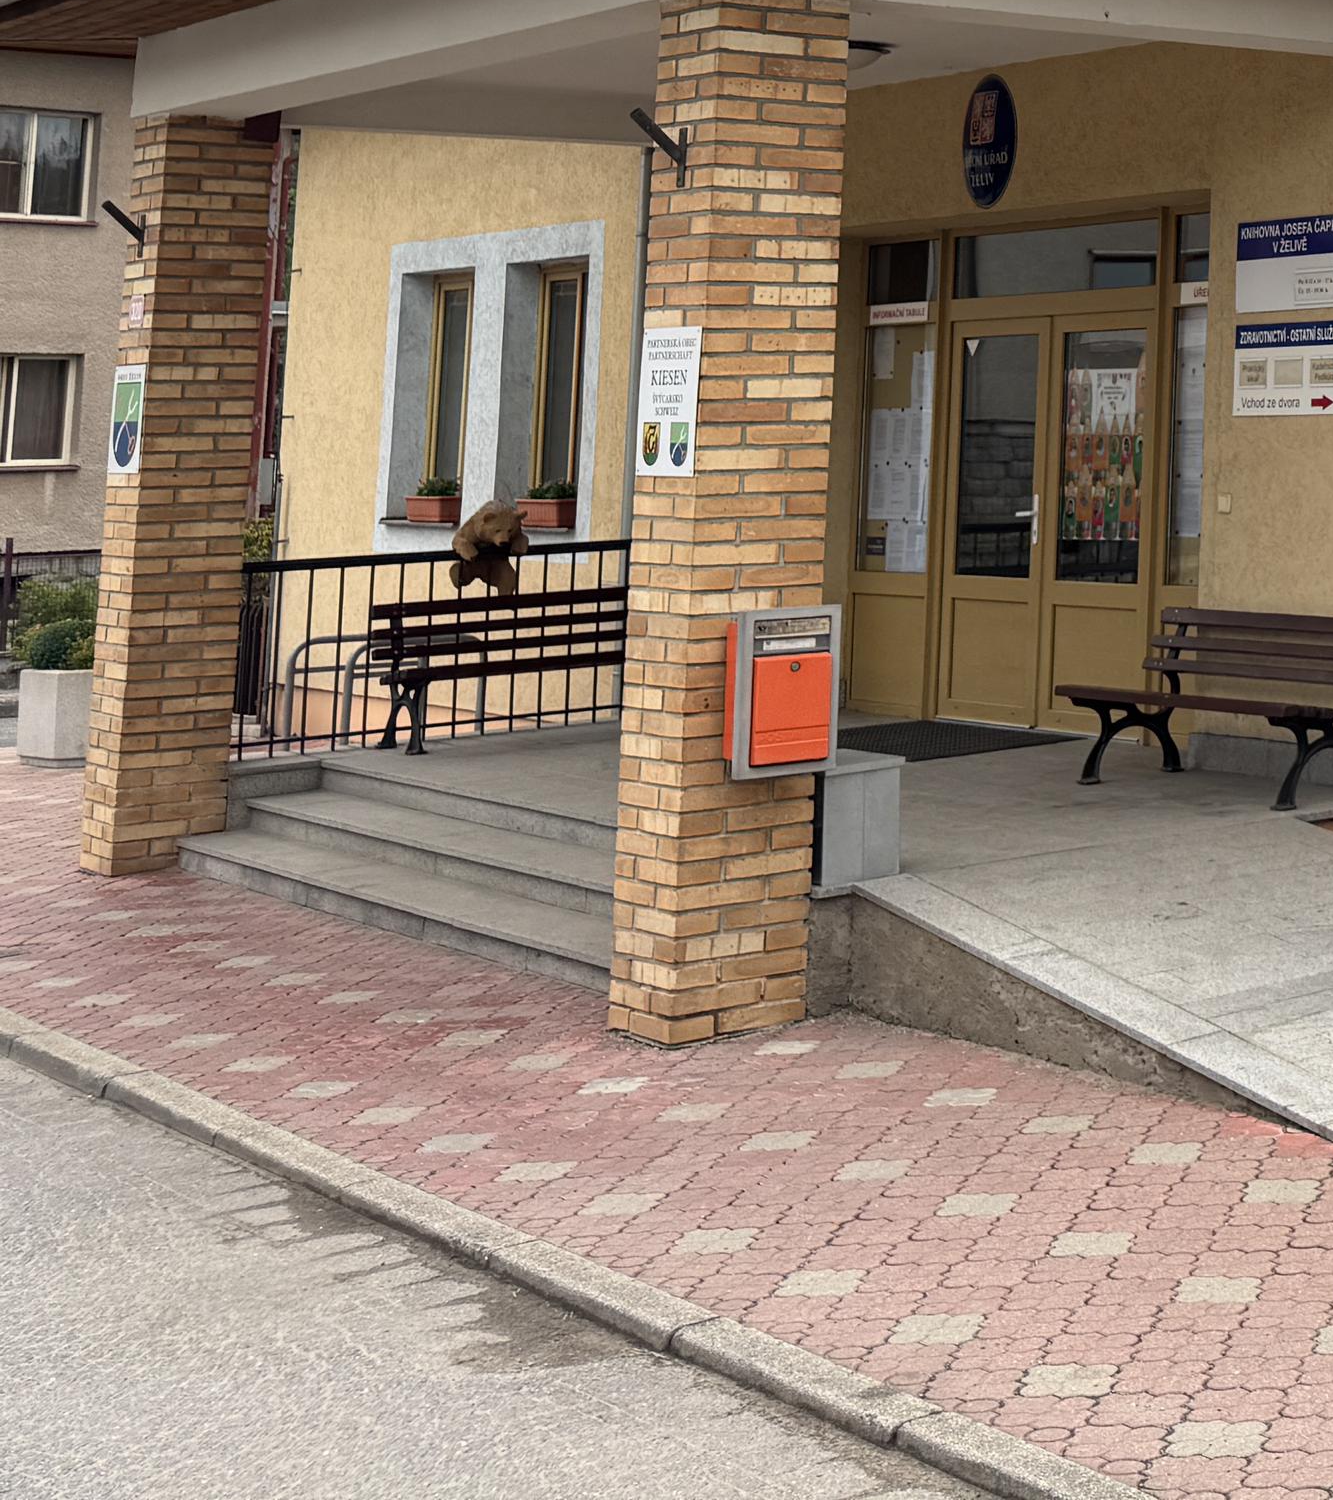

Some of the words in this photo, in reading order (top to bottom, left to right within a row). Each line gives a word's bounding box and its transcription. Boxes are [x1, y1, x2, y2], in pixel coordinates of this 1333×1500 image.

[1241, 224, 1280, 240] KNIHOVNA
[1282, 221, 1312, 236] JOSEFA
[1273, 241, 1279, 253] V
[1280, 236, 1307, 253] ŽELIVĚ
[872, 307, 905, 320] INFORMAČNÍ
[1240, 327, 1287, 345] ZDRAVOTNICTVÍ
[1290, 326, 1317, 342] OSTATNÍ
[647, 337, 682, 348] PARTNERSKÁ
[648, 351, 693, 360] PARTNERSCHAFT
[651, 369, 687, 386] KIESEN
[1241, 397, 1265, 409] Vchod
[1267, 399, 1277, 408] ze
[1278, 397, 1300, 408] dvora
[655, 407, 679, 416] SCHWEIZ
